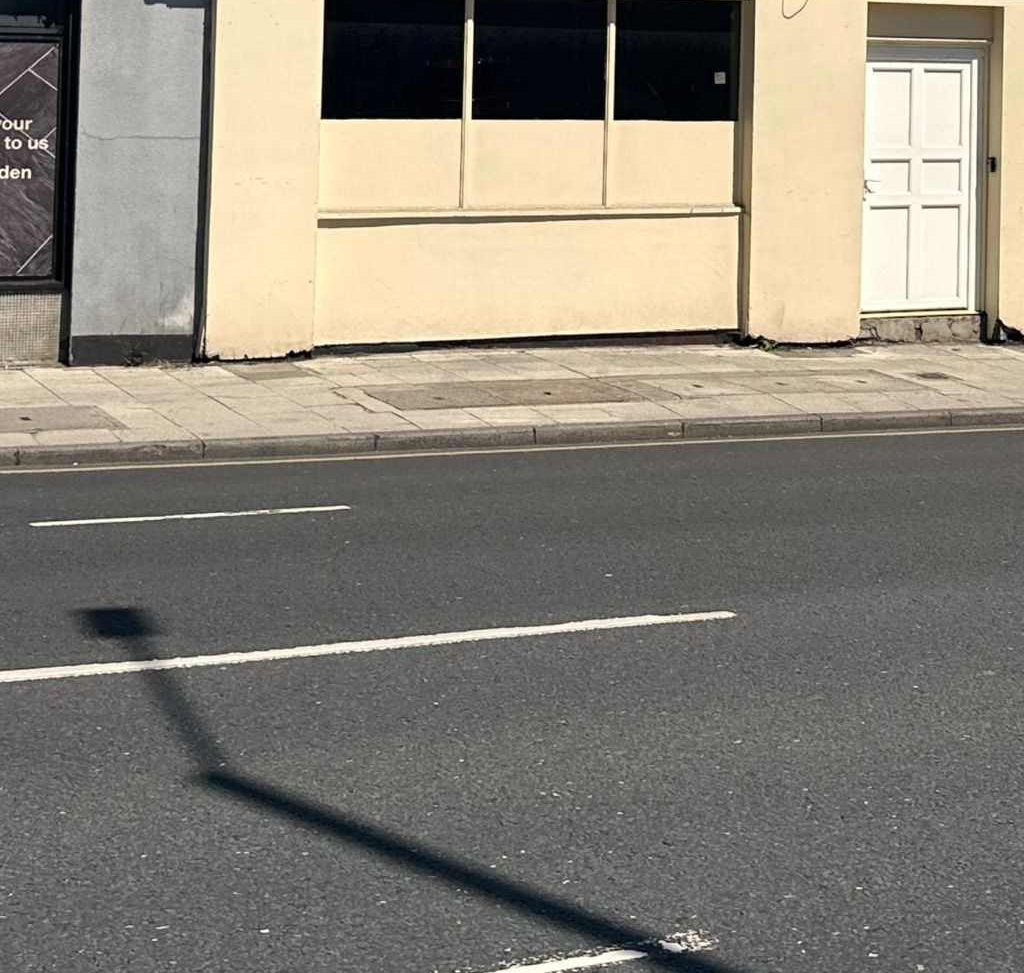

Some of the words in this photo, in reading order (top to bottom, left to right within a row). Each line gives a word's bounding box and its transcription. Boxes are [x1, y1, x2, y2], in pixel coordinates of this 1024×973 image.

[0, 119, 33, 131] our
[4, 136, 23, 150] to
[27, 138, 49, 150] us
